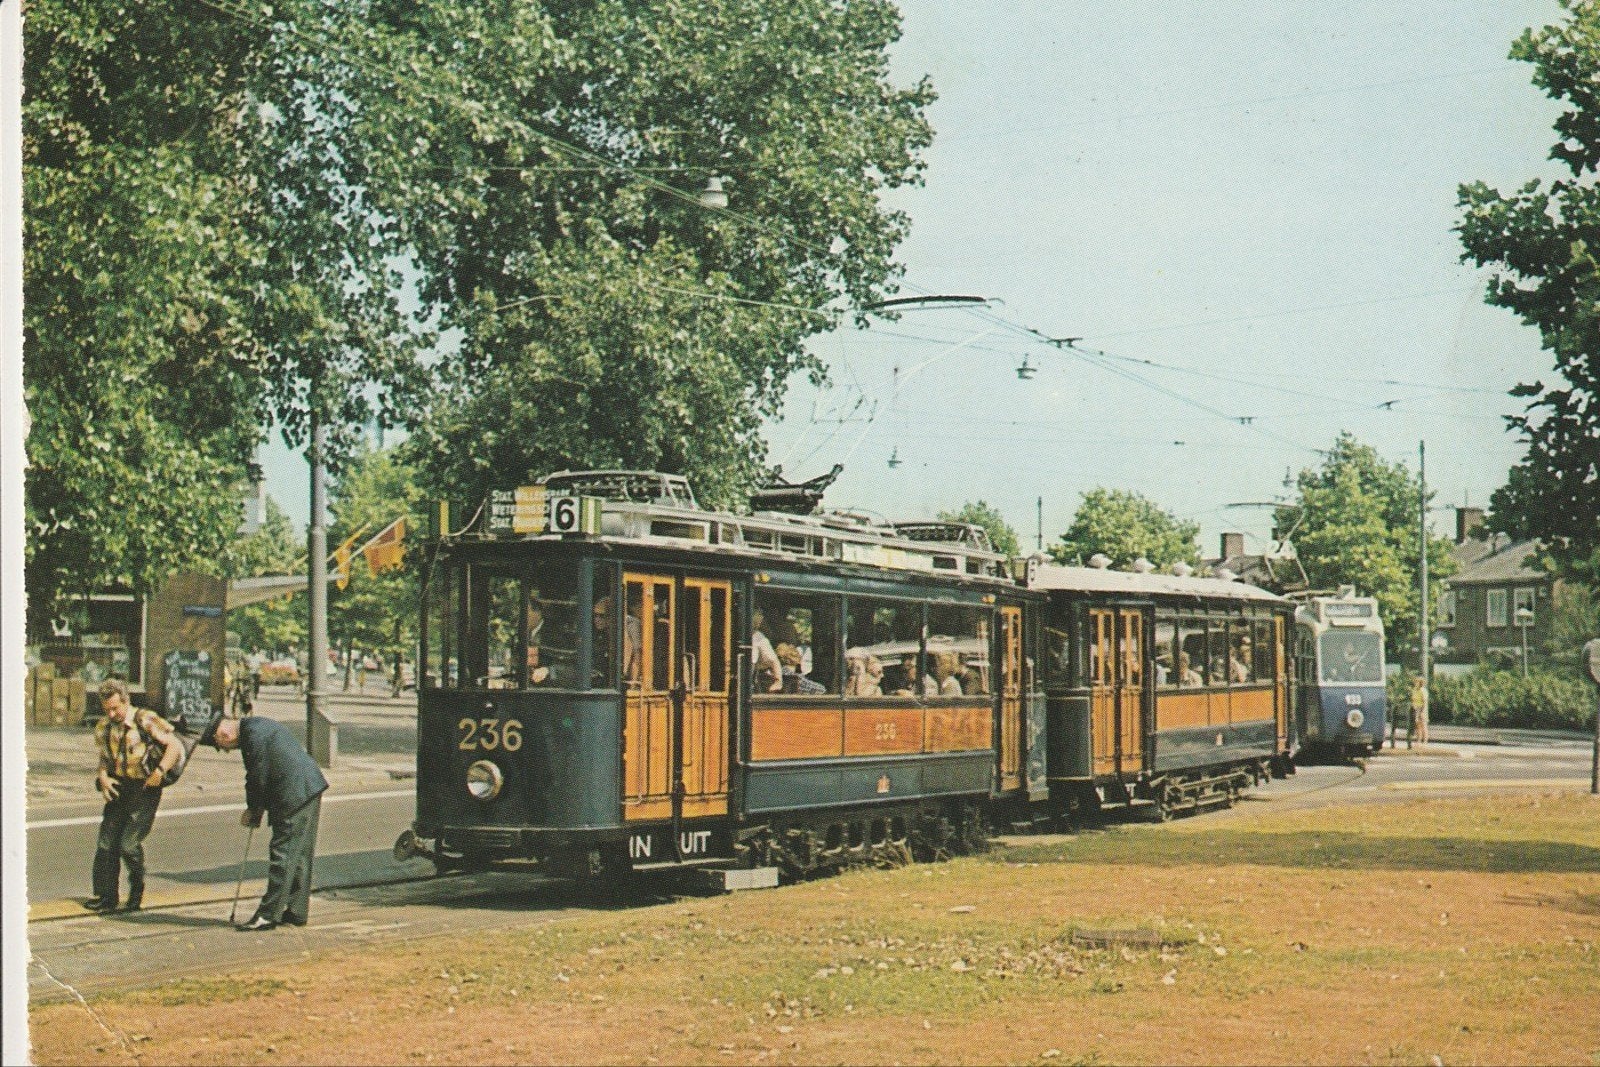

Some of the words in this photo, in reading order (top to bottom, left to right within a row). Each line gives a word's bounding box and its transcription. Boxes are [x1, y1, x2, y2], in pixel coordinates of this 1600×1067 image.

[555, 498, 575, 531] 6
[458, 717, 524, 752] 236
[875, 722, 896, 740] 236
[629, 834, 651, 858] IN
[681, 830, 712, 854] UIT
